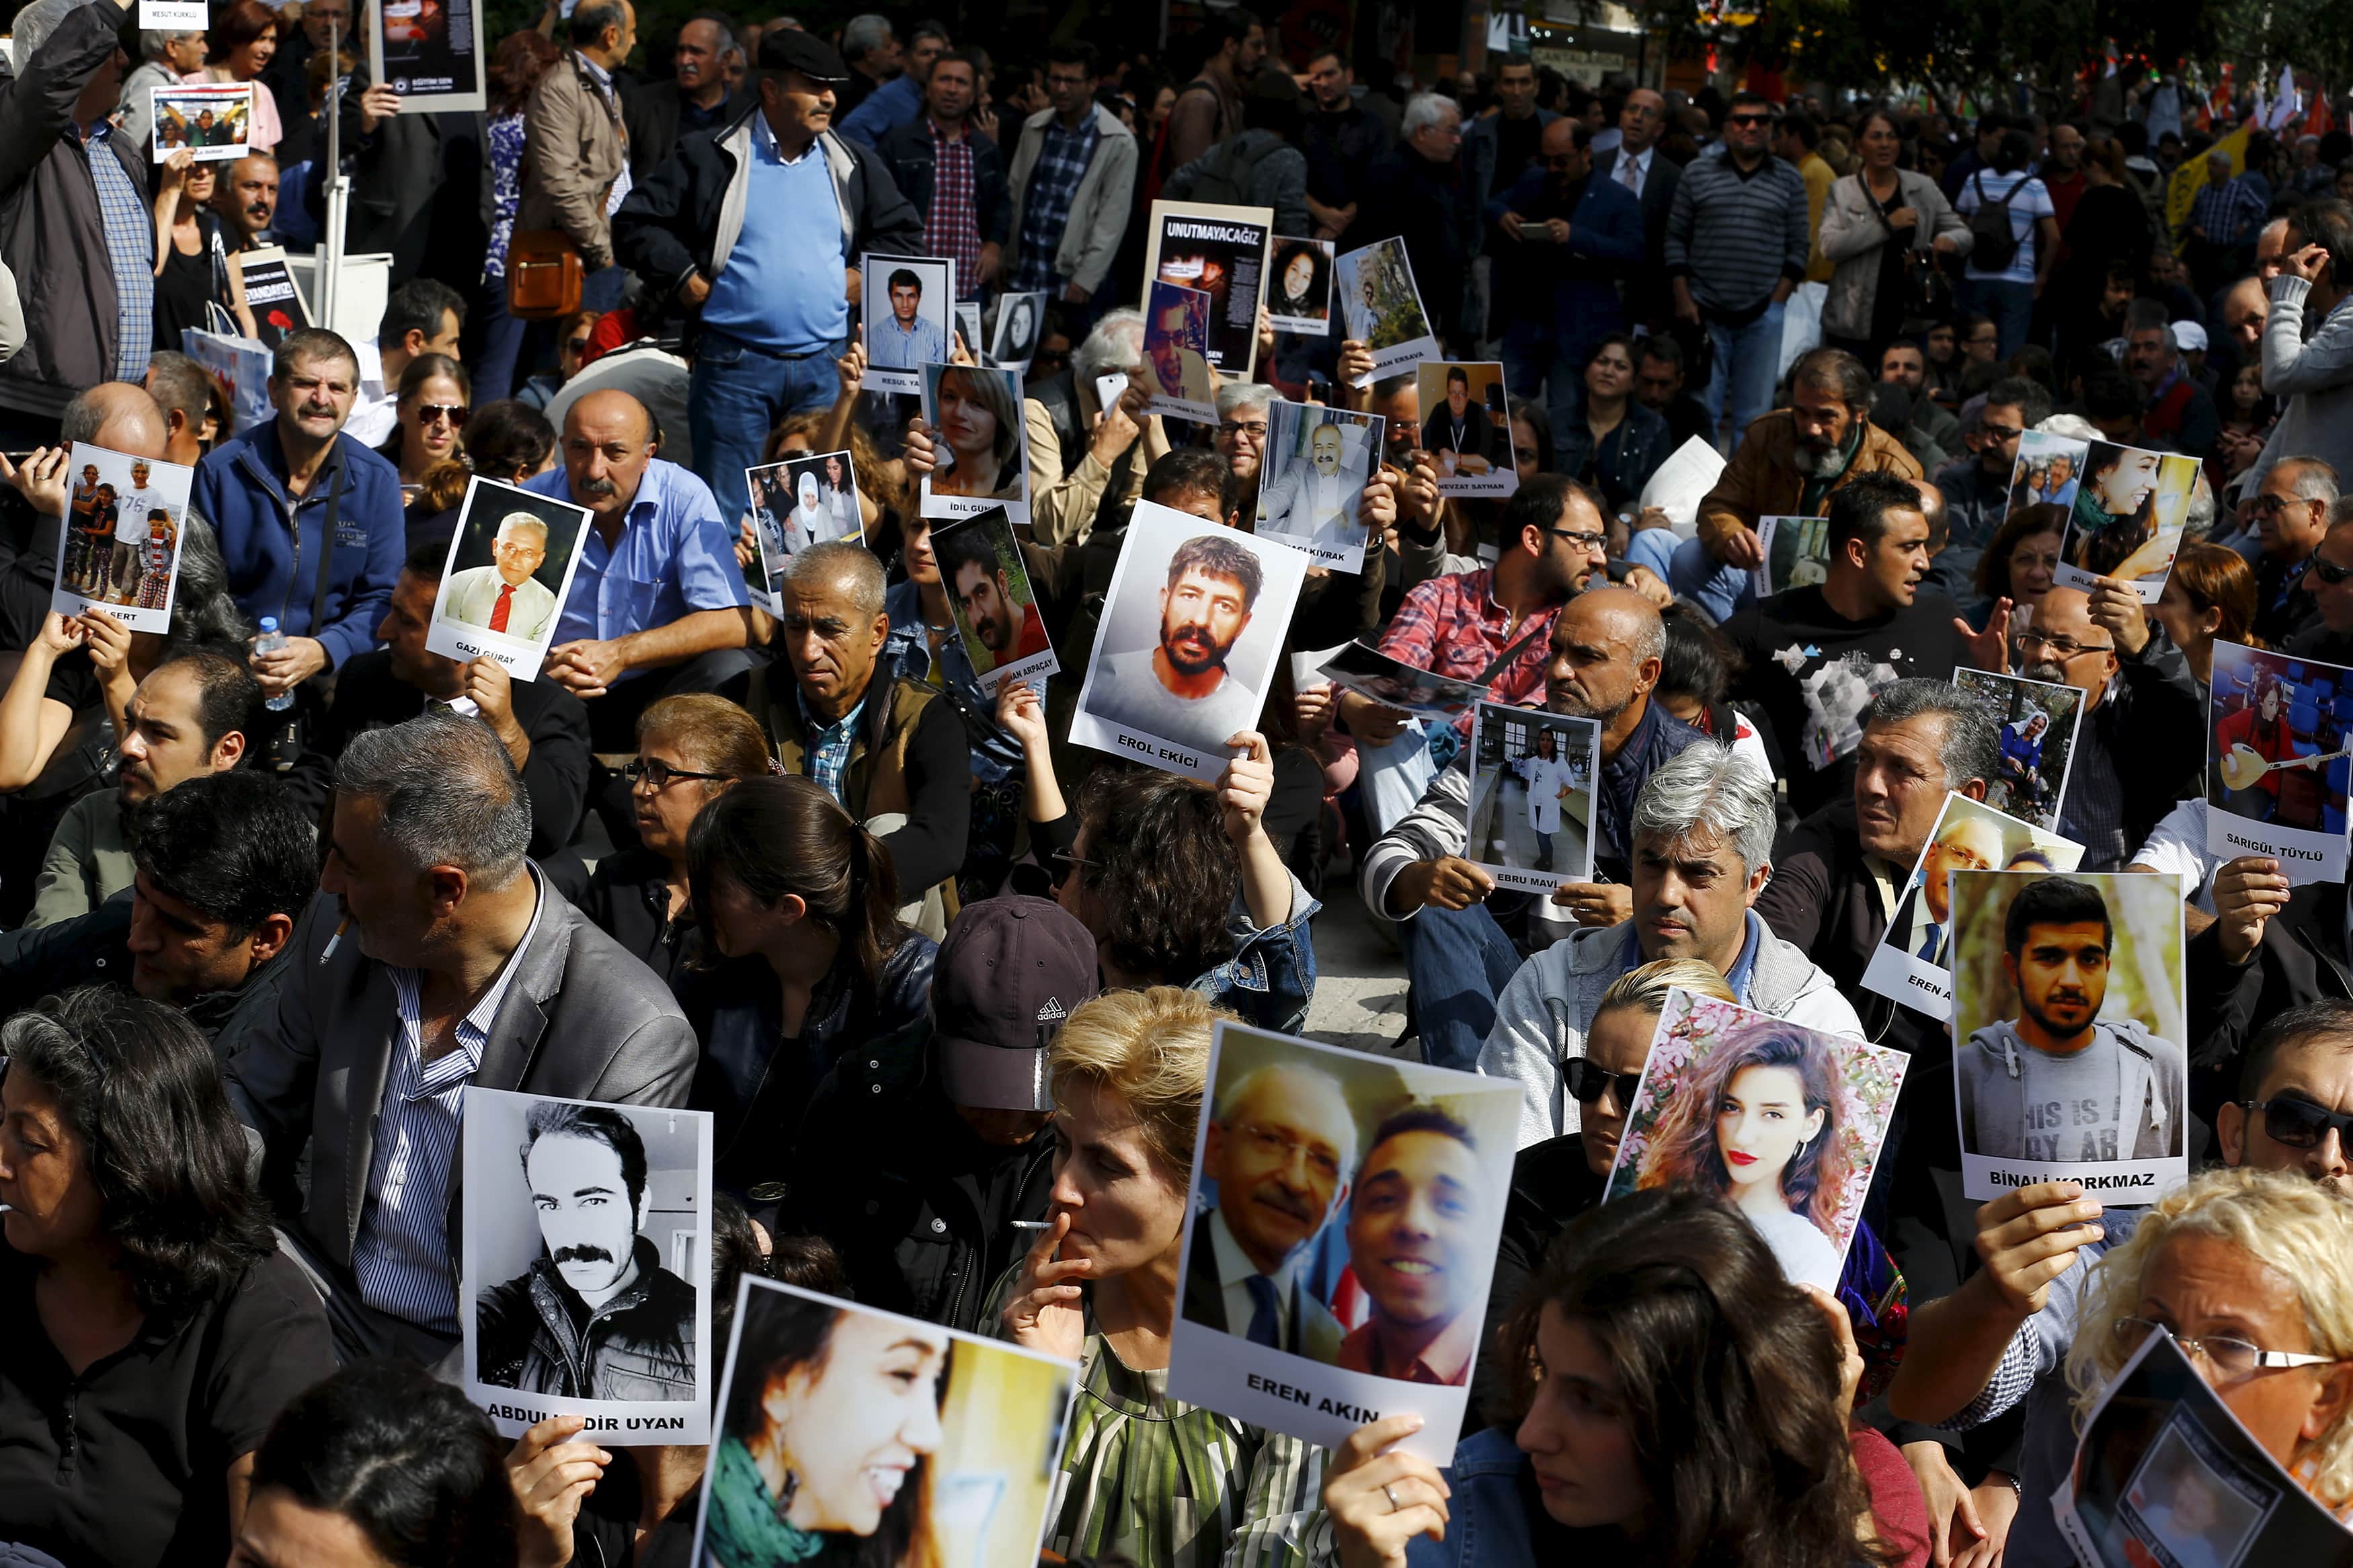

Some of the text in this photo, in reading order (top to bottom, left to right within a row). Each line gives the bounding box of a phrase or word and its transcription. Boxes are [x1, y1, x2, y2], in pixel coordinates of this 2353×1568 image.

[1167, 222, 1261, 246] UNUTMAYACAĞIZ
[882, 378, 907, 386] RESUL
[950, 502, 995, 512] İDİL GÜN
[1310, 548, 1345, 561] KIVRAK
[110, 611, 137, 621] SERT
[456, 641, 481, 655] GAZİ
[1023, 659, 1053, 677] ARPAÇAY
[1117, 733, 1199, 769] EROL EKİCİ
[2227, 833, 2324, 862] SARIGÜL TÜYLÜ
[1497, 873, 1558, 889] EBRU MAVİ
[1907, 974, 1942, 995] EREN
[1037, 1011, 1066, 1020] adidas
[2056, 1173, 2155, 1190] ORKMAZ
[1247, 1373, 1380, 1424] EREN AKIN
[487, 1403, 684, 1430] ABDULDİR UYAN
